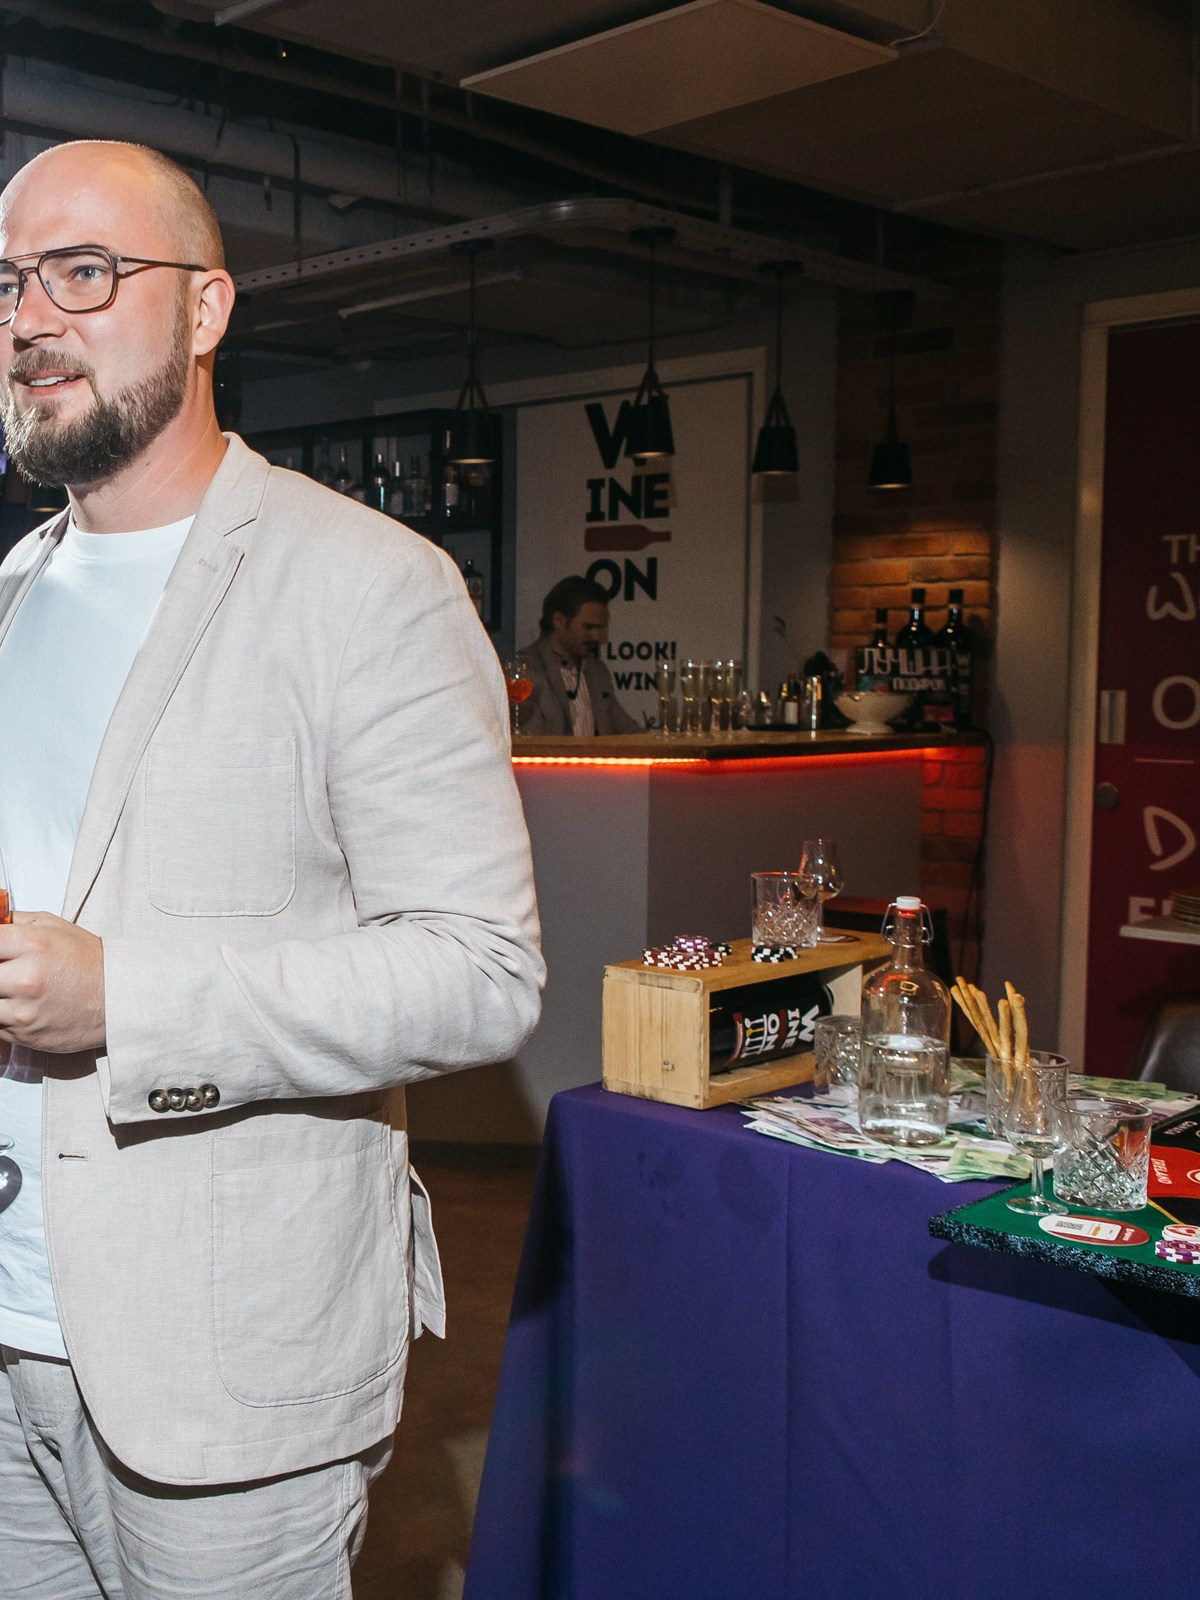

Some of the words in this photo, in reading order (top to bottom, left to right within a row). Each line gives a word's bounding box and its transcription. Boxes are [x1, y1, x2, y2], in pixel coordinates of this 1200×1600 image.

[586, 473, 670, 521] INE
[585, 555, 657, 600] ON
[607, 641, 676, 660] LOOK!
[761, 1013, 780, 1052] ON
[781, 1007, 800, 1050] INE
